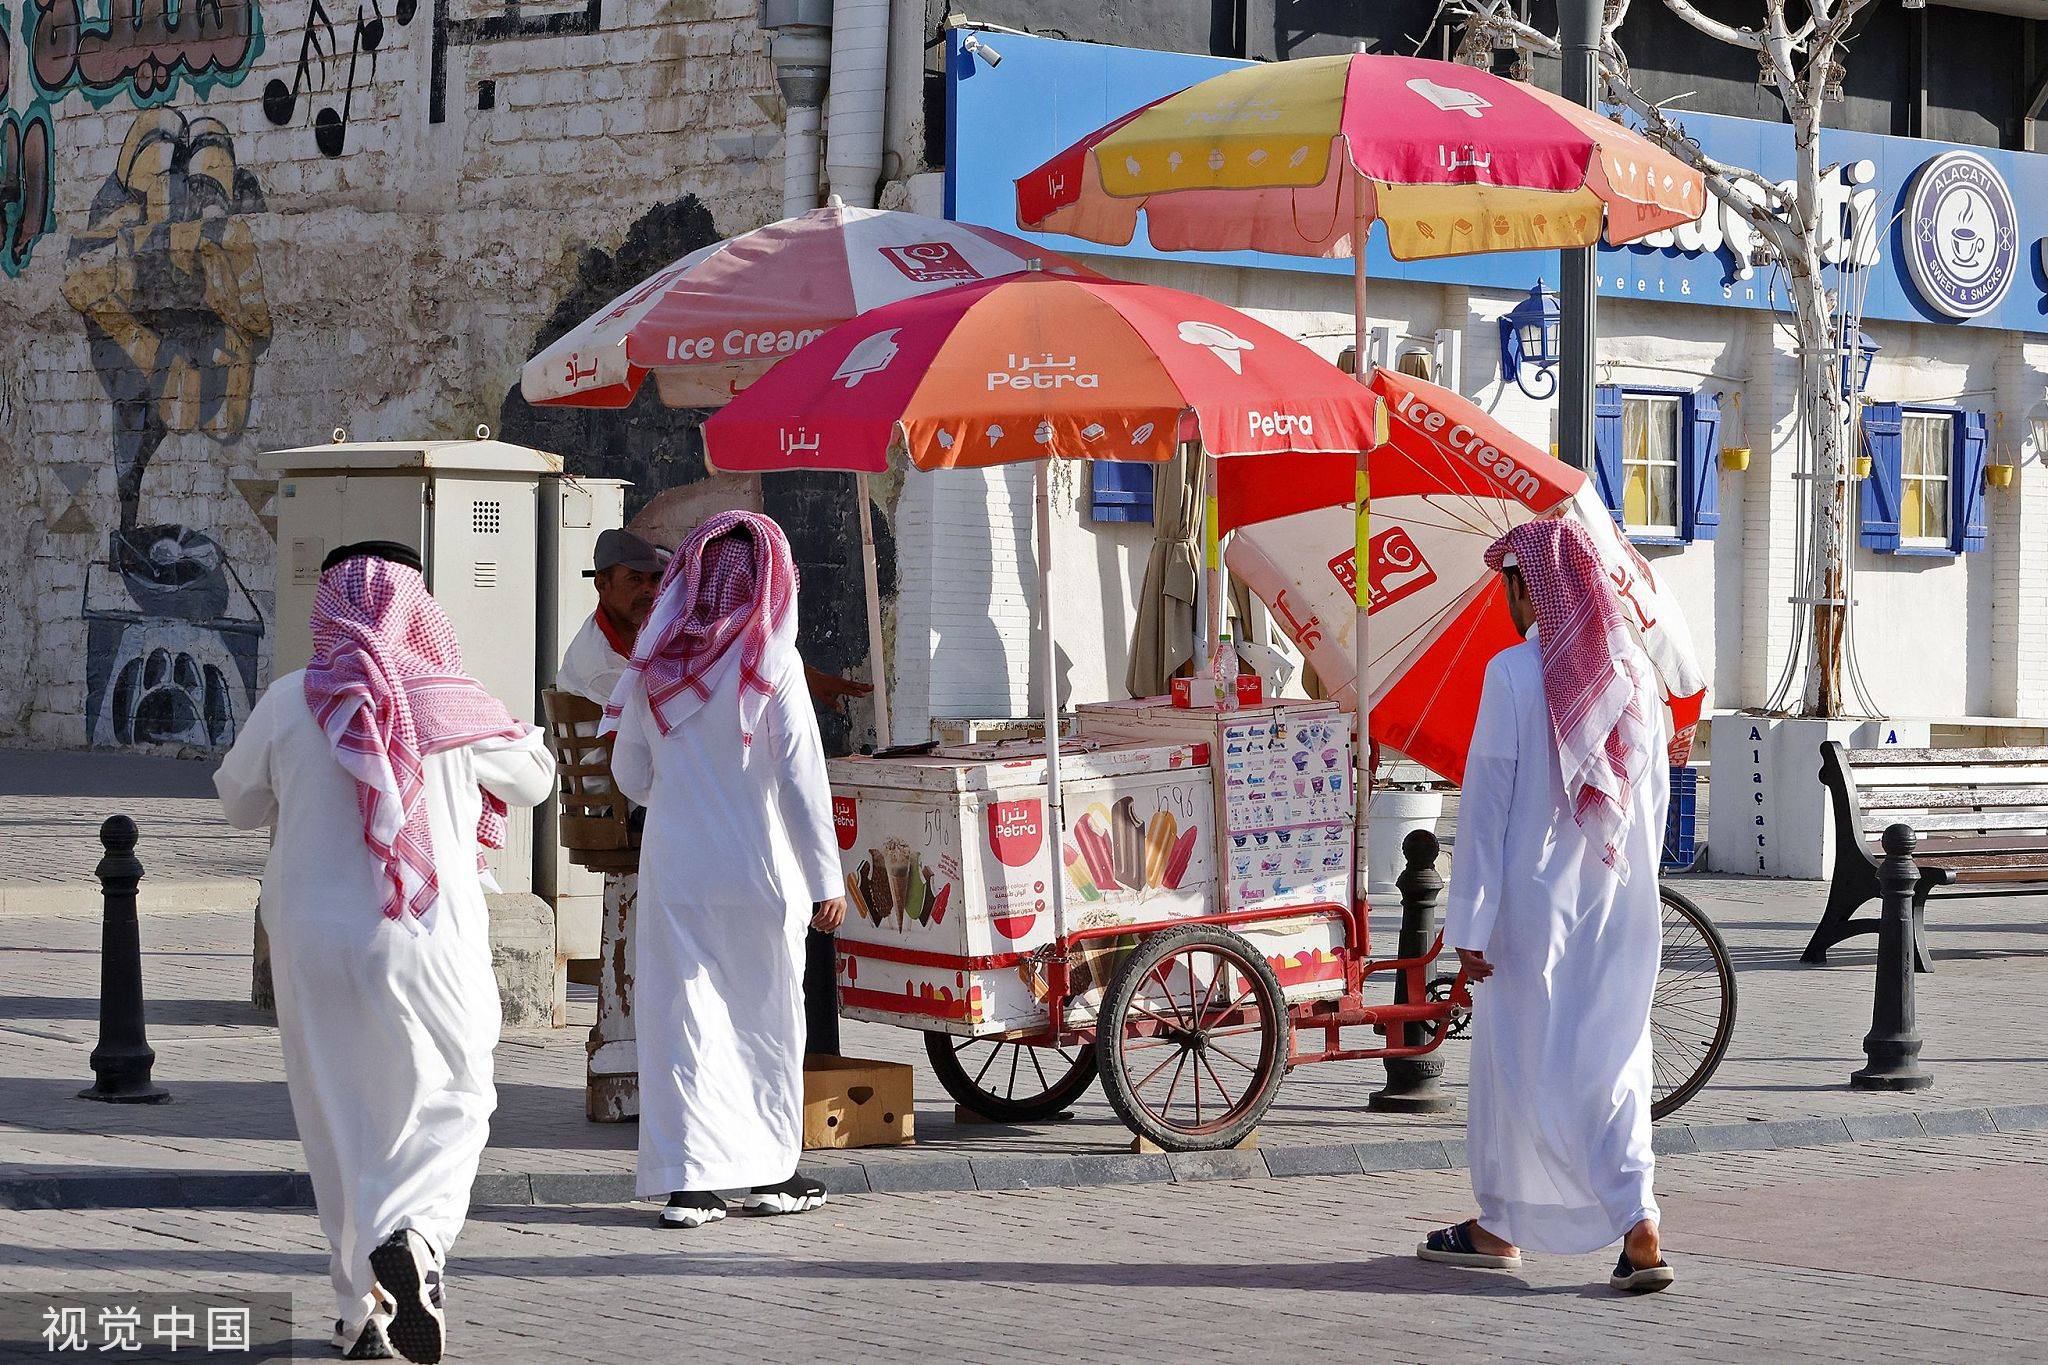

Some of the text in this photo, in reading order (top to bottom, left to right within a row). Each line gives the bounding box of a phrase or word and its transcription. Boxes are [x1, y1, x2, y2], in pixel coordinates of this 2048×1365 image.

[1439, 144, 1491, 175] بترا
[1934, 165, 1992, 194] ALAÇATI
[1681, 279, 1691, 295] &
[1929, 259, 1958, 296] SWEET
[1960, 289, 1967, 301] &
[1970, 266, 2002, 301] SNACKS
[666, 329, 825, 360] Ice Cream
[1008, 353, 1077, 371] بترا
[987, 371, 1099, 391] Petra
[1248, 410, 1313, 438] Petra
[780, 426, 820, 456] بترا
[1397, 391, 1540, 500] Ice Cream
[1748, 726, 1765, 870] Alaçati
[1002, 807, 1028, 824] بترا
[995, 824, 1037, 839] Petra
